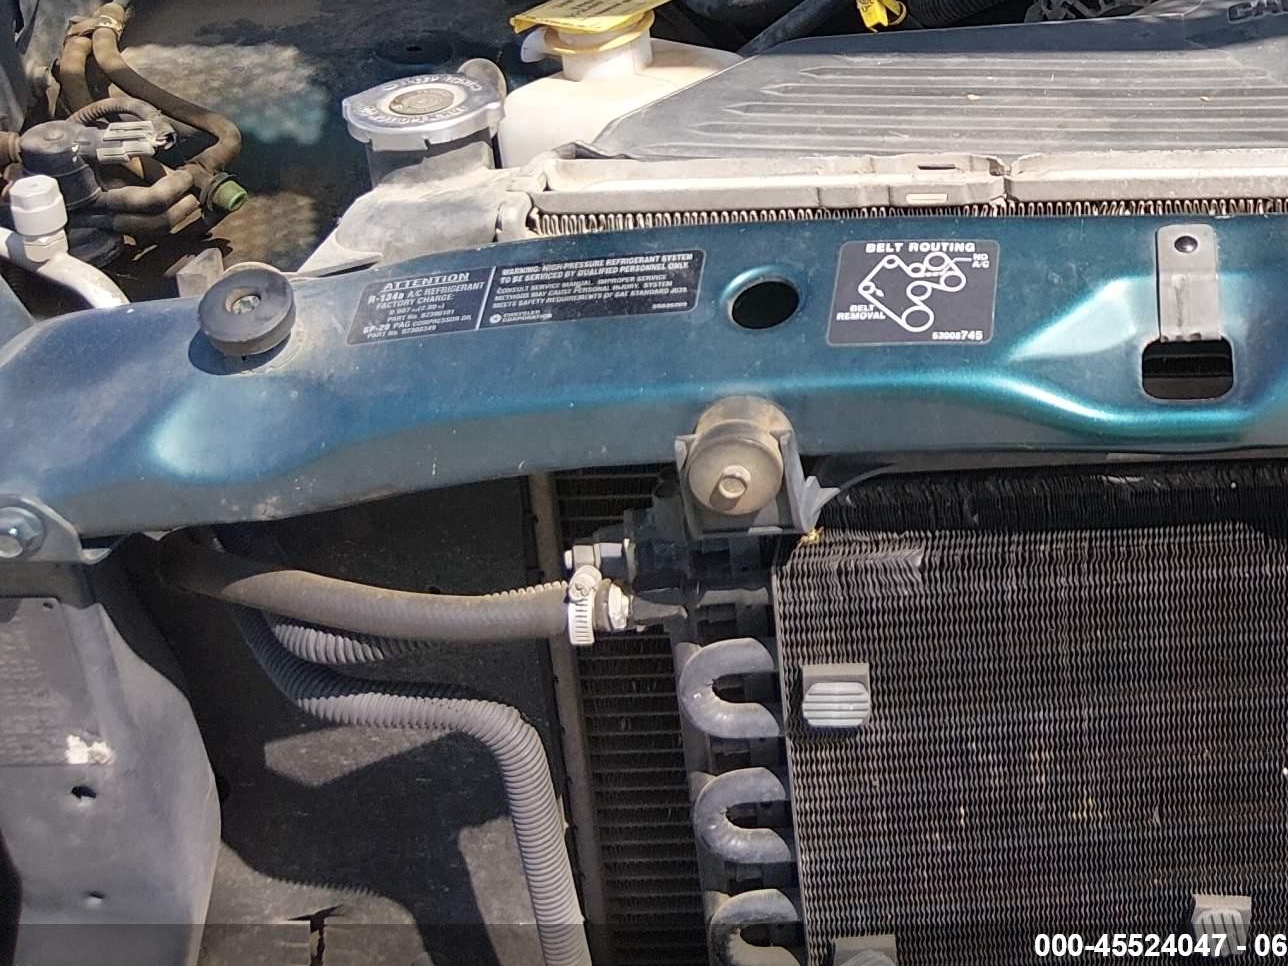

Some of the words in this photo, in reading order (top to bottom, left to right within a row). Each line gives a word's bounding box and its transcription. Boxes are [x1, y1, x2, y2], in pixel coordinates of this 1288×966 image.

[865, 242, 904, 253] BELT
[908, 242, 976, 253] ROUTING
[502, 265, 541, 275] WARNING:
[542, 259, 605, 272] HIGH-PRESSURE
[605, 255, 661, 267] REFRIGERANT
[662, 253, 694, 263] SYSTEM
[500, 276, 511, 284] TO
[512, 275, 524, 283] BE
[525, 272, 563, 282] SERVICED
[564, 270, 575, 278] BY
[577, 267, 619, 277] QUALIFIED
[619, 263, 666, 274] PERSONNEL
[384, 272, 471, 291] ATTENTION
[423, 282, 486, 296] REFRIGERANT
[497, 285, 530, 295] CONSULT
[531, 282, 561, 291] SERVICE
[597, 276, 636, 285] IMPROPER
[636, 273, 668, 282] SERVICE
[518, 297, 545, 306] SAFETY
[545, 293, 603, 304] REQUIREMENTS
[630, 287, 669, 297] STANDARD
[531, 290, 547, 299] MAY
[548, 288, 573, 297] CAUSE
[573, 285, 612, 295] PERSONAL
[643, 280, 673, 289] SYSTEM
[375, 297, 416, 311] FACTORY
[417, 294, 455, 305] CHARGE:
[849, 304, 875, 312] BELT
[387, 315, 407, 323] PART
[393, 320, 411, 329] PAG
[412, 316, 459, 327] COMPRESSOR
[836, 312, 886, 321] REMOVAL
[367, 331, 387, 339] PART
